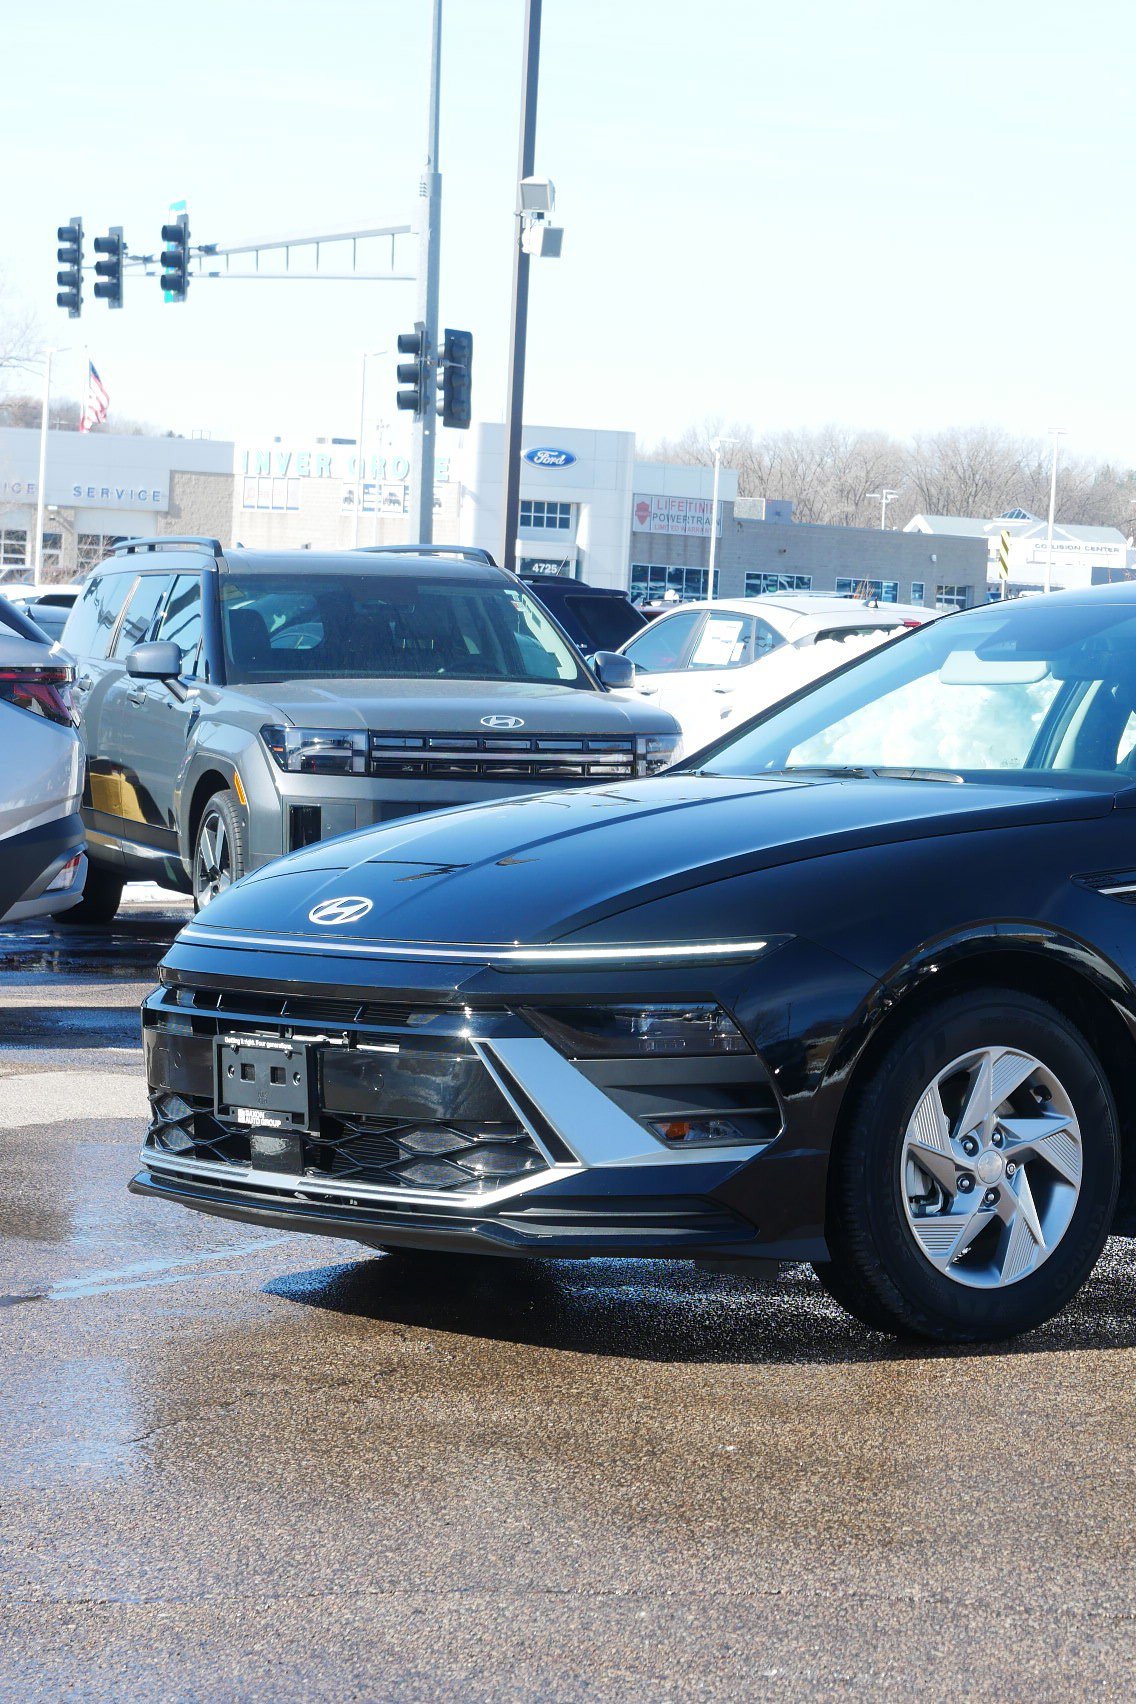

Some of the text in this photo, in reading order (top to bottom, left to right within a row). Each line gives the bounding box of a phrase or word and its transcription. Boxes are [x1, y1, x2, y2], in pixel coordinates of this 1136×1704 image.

[534, 450, 566, 465] Ford
[242, 450, 450, 482] INVER GROE
[73, 485, 161, 502] SERVICE
[652, 512, 720, 527] POWERTRAN
[1034, 543, 1120, 553] COLISION CENTER
[532, 563, 558, 574] 4725
[260, 1118, 282, 1128] GROUP
